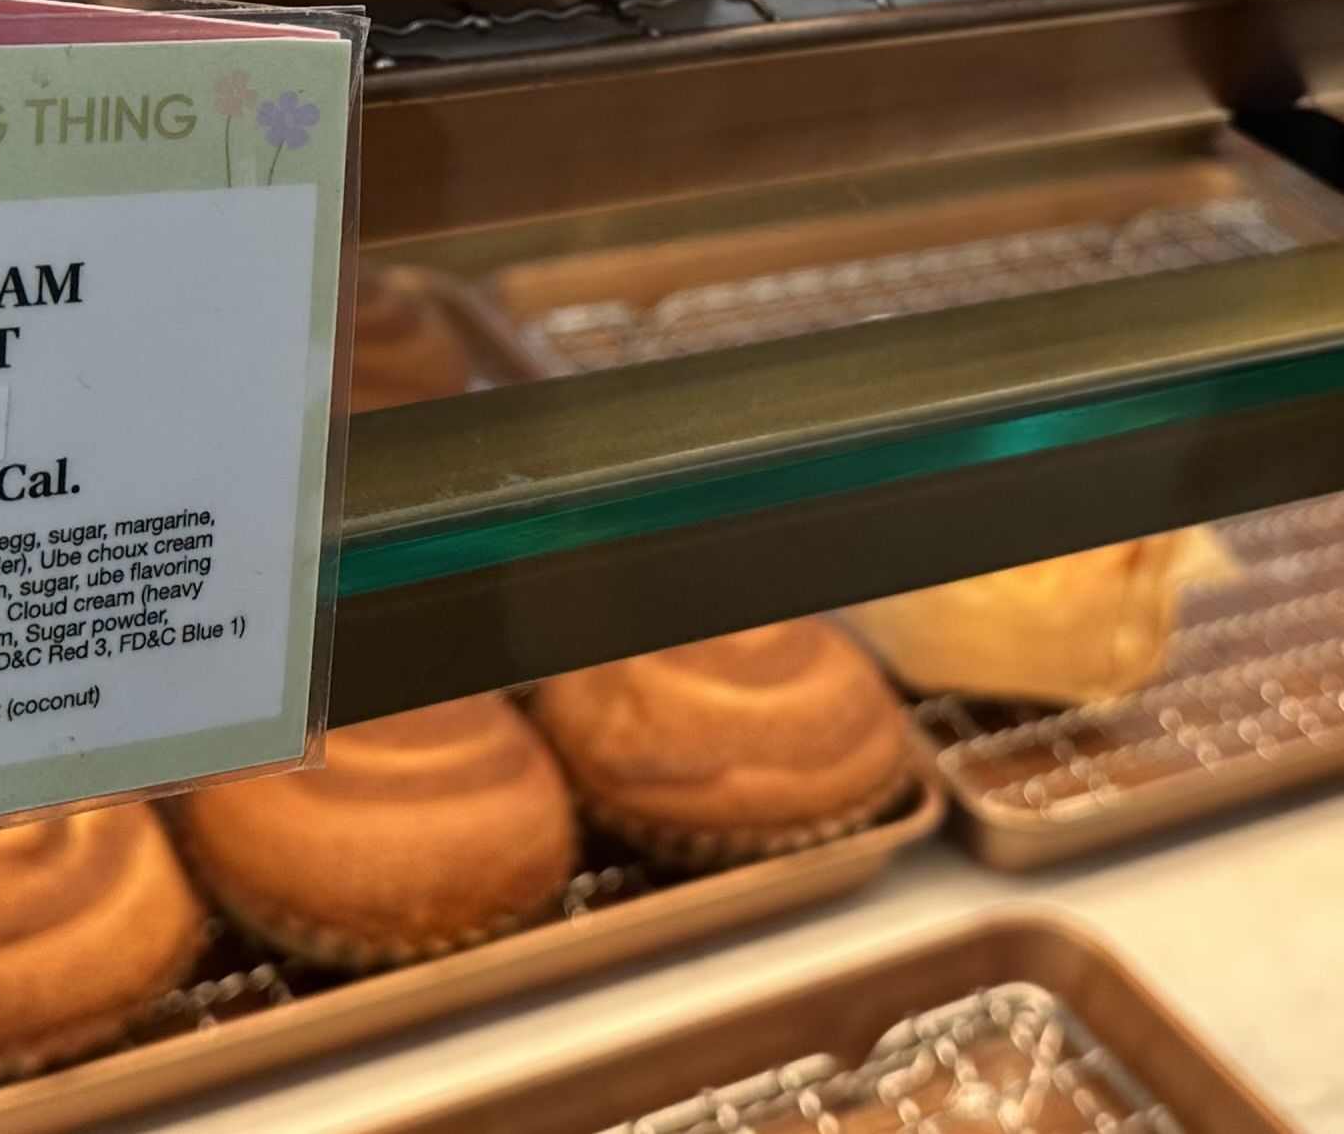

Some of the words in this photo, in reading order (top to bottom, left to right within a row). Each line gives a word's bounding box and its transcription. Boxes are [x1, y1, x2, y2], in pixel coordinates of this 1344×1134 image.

[25, 93, 198, 146] THING
[48, 523, 108, 546] sugar,
[114, 509, 215, 536] margarine,
[40, 548, 82, 570] Ube
[88, 542, 148, 564] choux
[154, 533, 213, 555] cream
[20, 573, 79, 597] sugar,
[87, 567, 124, 587] ube
[130, 556, 211, 582] flavoring
[7, 596, 67, 622] Cloud
[73, 590, 134, 613] cream
[141, 580, 204, 607] (heavy
[25, 619, 86, 644] Sugar
[91, 608, 169, 637] powder,
[48, 640, 89, 665] Red
[94, 638, 113, 658] 3,
[119, 627, 176, 653] FD&C
[182, 621, 224, 643] Blue
[230, 616, 246, 639] 1)
[7, 685, 101, 722] (coconut)
